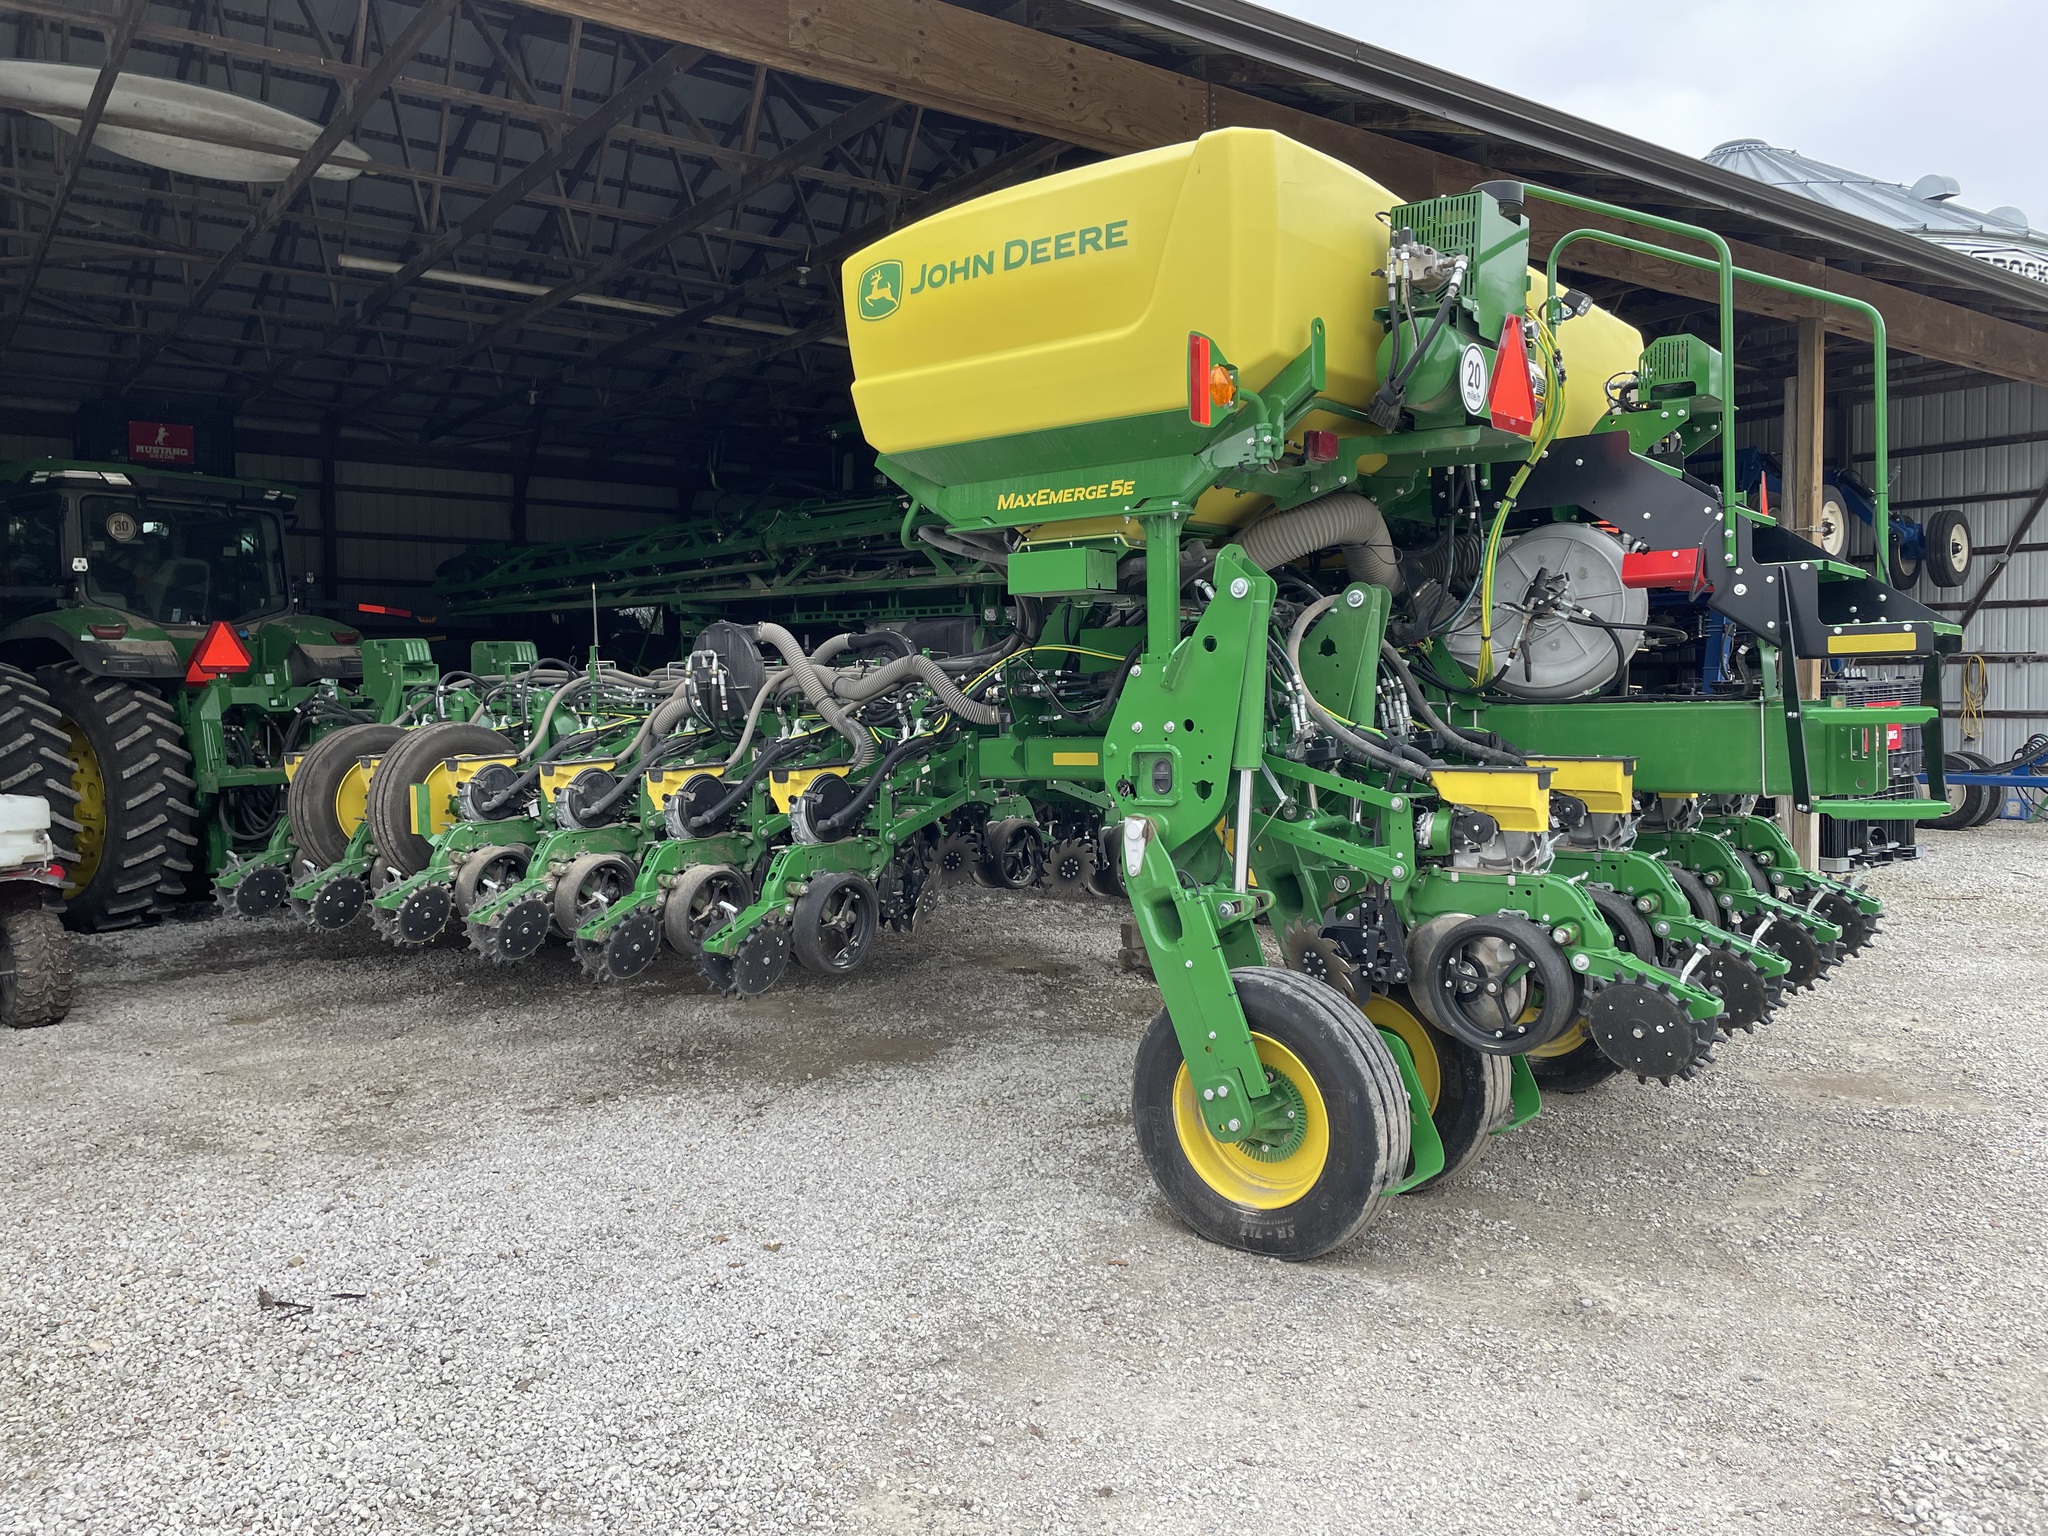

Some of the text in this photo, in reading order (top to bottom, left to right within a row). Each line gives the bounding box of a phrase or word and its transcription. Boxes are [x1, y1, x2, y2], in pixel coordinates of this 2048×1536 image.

[910, 219, 1129, 295] JOHN DEERE
[1467, 360, 1481, 390] 20
[135, 444, 189, 456] MUSTANG
[996, 479, 1136, 511] MAXEMERGE 5E
[114, 520, 129, 531] 30
